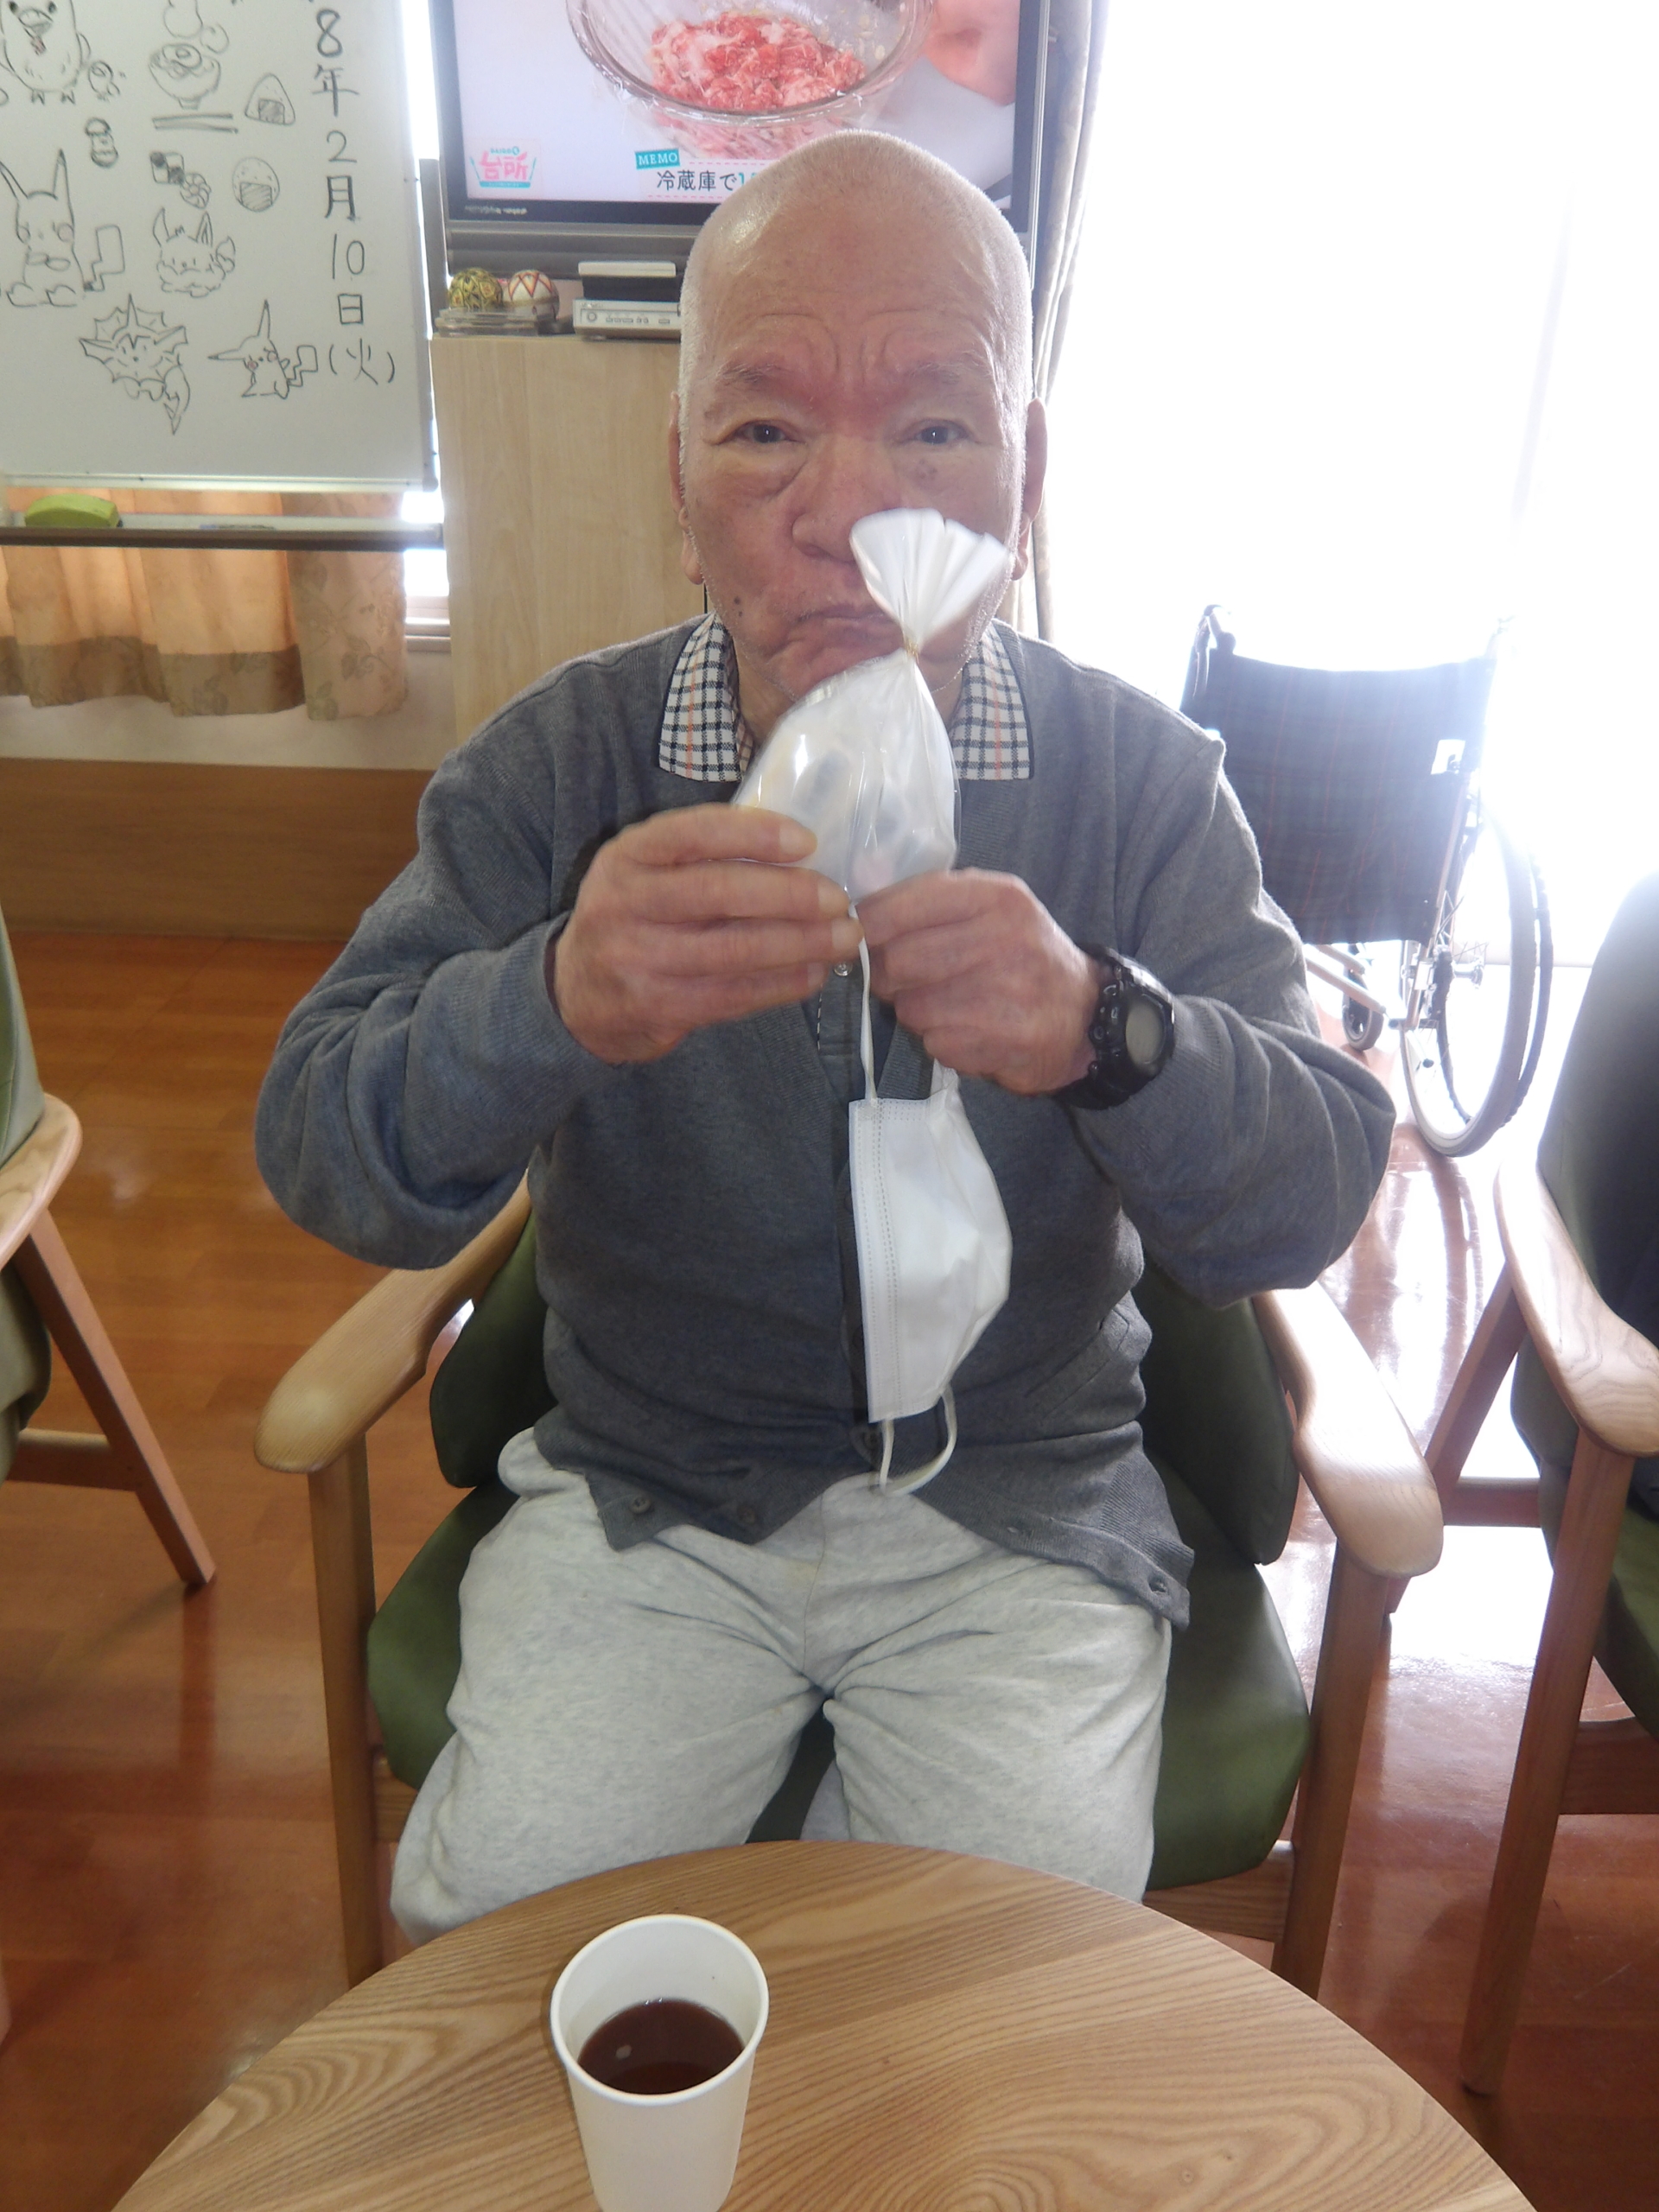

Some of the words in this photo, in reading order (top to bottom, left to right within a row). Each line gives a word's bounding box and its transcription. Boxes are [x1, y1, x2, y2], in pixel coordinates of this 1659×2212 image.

[479, 150, 529, 181] 台所
[638, 152, 678, 166] MEMO
[657, 169, 757, 192] 冷蔵庫で1
